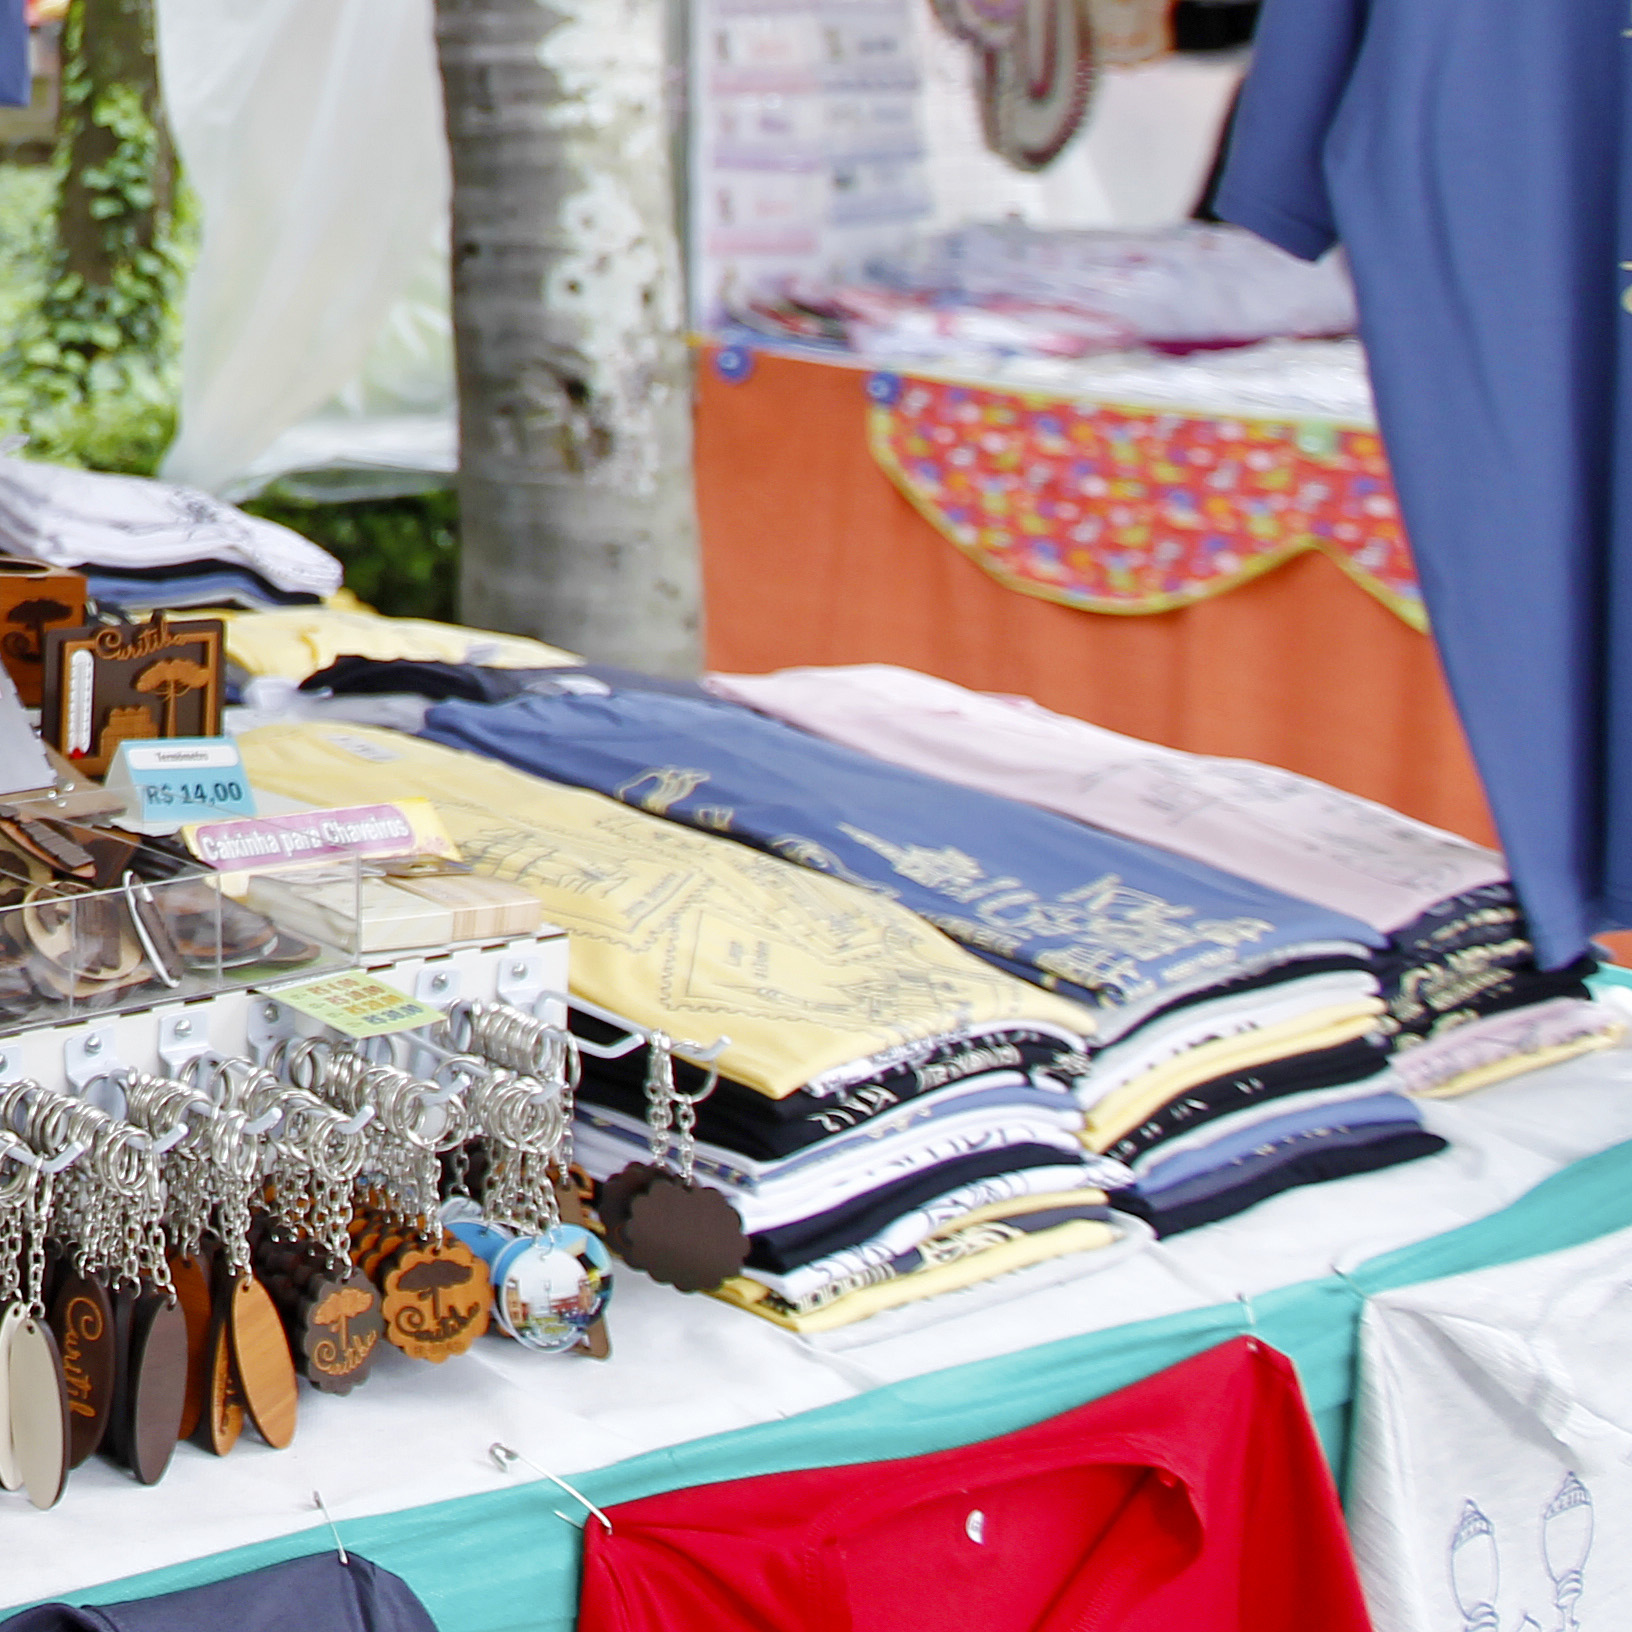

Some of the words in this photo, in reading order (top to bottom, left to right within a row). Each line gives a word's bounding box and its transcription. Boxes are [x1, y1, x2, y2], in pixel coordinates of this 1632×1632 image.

[95, 620, 192, 661] Curitiba
[146, 783, 173, 805] R$
[181, 781, 244, 805] 14,00
[200, 828, 280, 863] Caixinha
[280, 827, 320, 857] para
[320, 813, 410, 844] Chaveiros
